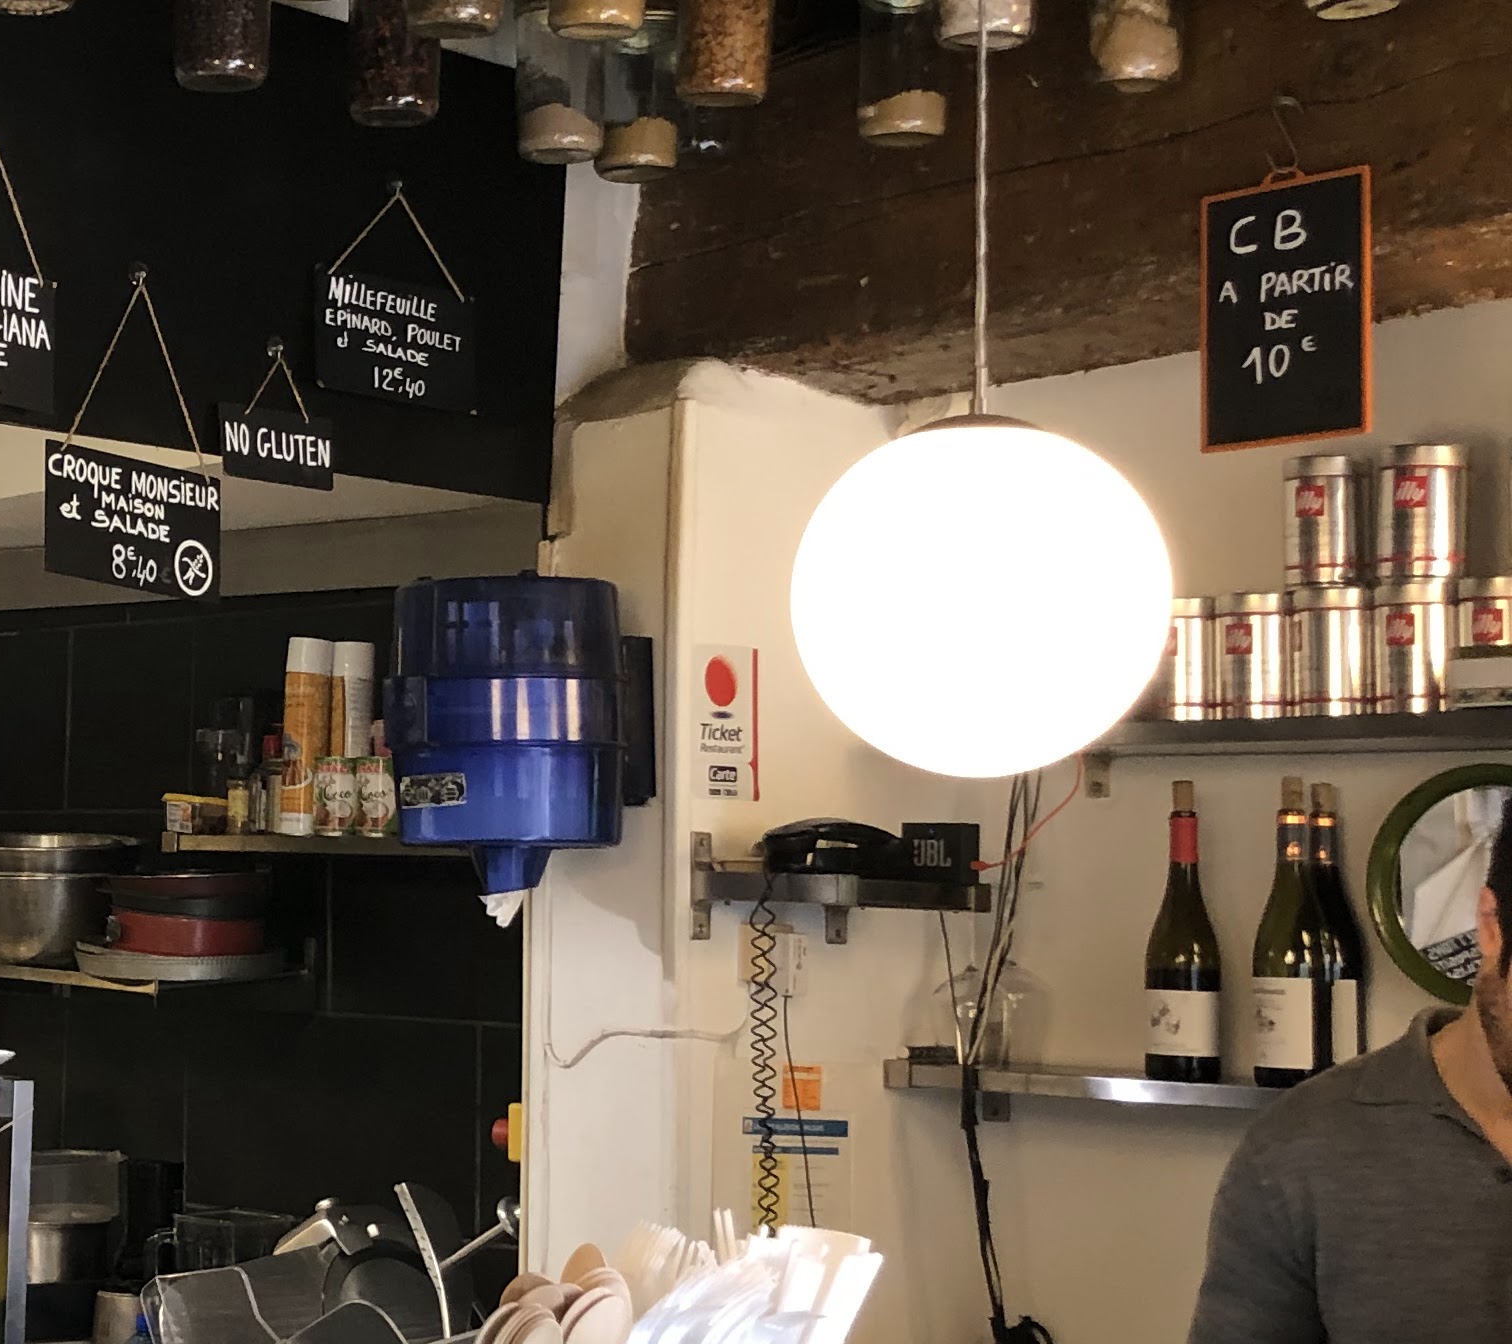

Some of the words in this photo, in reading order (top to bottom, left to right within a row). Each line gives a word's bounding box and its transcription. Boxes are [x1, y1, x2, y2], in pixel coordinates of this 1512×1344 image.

[1263, 309, 1299, 331] DE
[405, 321, 463, 354] POULET
[362, 338, 430, 368] SALADE
[224, 420, 249, 456] NO
[256, 427, 332, 470] GLUTEN
[47, 452, 123, 500] CROQUE
[58, 493, 83, 523] et
[90, 510, 171, 544] SALADE
[700, 722, 743, 742] Ticket
[709, 767, 737, 782] Carte
[913, 839, 952, 868] JBL
